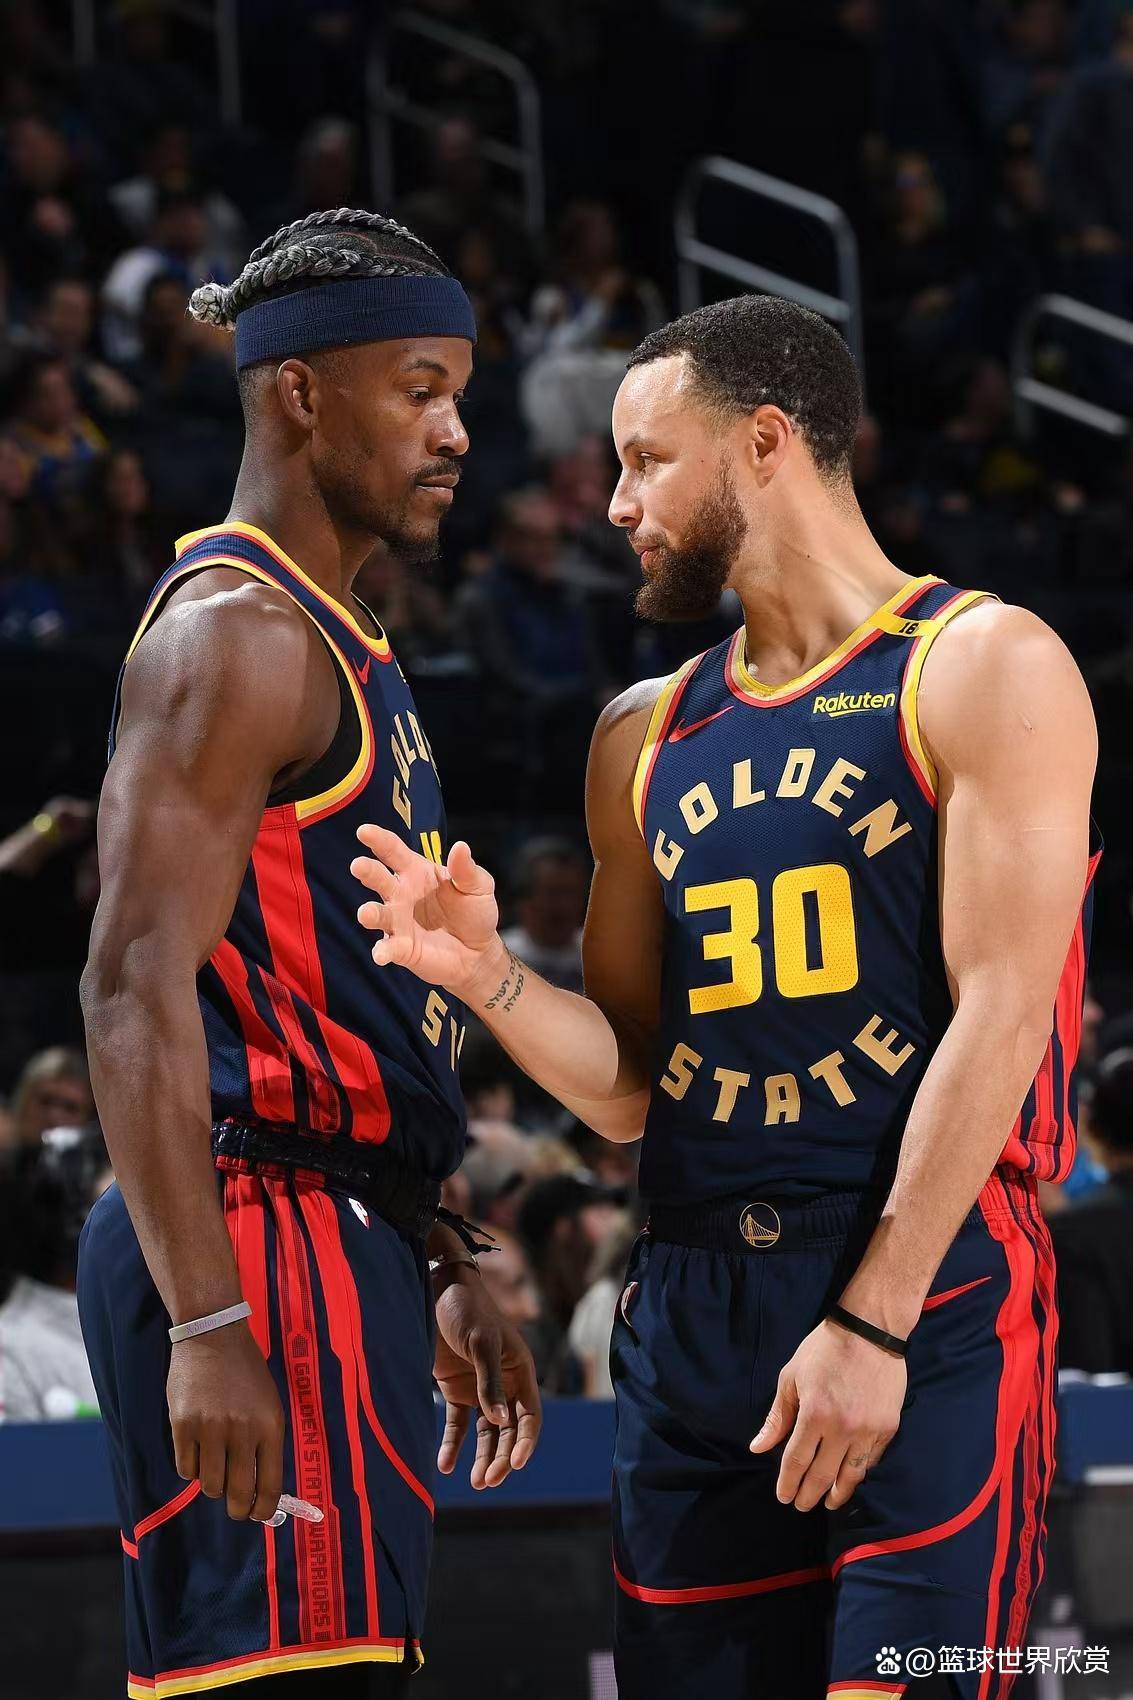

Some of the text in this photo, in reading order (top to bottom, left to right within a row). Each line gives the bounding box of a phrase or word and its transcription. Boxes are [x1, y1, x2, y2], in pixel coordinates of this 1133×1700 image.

[898, 621, 920, 635] 16
[812, 691, 896, 715] Rakuten
[653, 747, 913, 882] GOLDEN
[684, 863, 859, 1015] 30
[659, 1014, 915, 1126] STATE
[294, 1362, 320, 1445] GOLDEN
[303, 1448, 323, 1510] STAT
